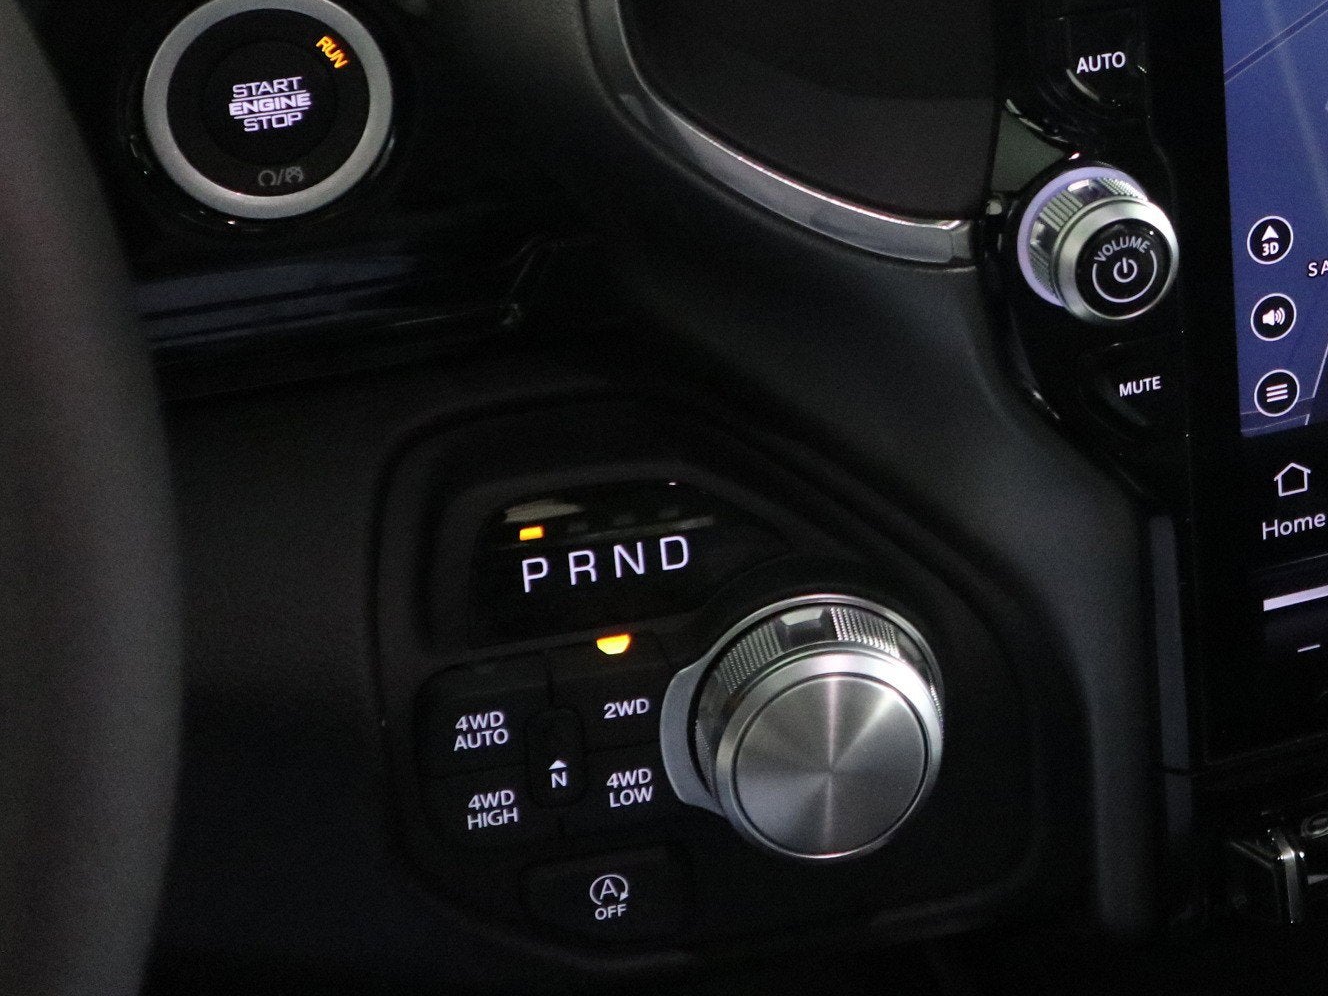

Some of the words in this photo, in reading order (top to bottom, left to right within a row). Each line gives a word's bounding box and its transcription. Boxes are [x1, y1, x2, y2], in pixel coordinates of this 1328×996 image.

[315, 35, 349, 70] RUN
[1076, 52, 1126, 74] AUTO
[233, 76, 303, 99] START
[229, 92, 312, 117] ENGINE
[243, 111, 303, 132] STOP
[1094, 235, 1151, 264] VOLUME
[1262, 243, 1279, 257] 3D
[1308, 262, 1318, 277] S
[1119, 375, 1162, 397] MUTE
[1262, 512, 1326, 540] Home
[521, 556, 549, 593] P
[567, 549, 597, 585] R
[613, 541, 645, 578] N
[659, 534, 690, 571] D
[603, 698, 650, 720] 2WD
[455, 710, 505, 732] 4WD
[453, 729, 509, 752] AUTO
[551, 771, 567, 789] N
[606, 768, 652, 789] 4WD
[467, 789, 515, 811] 4WD
[608, 785, 654, 808] LOW
[467, 807, 519, 830] HIGH
[594, 903, 627, 921] OFF
